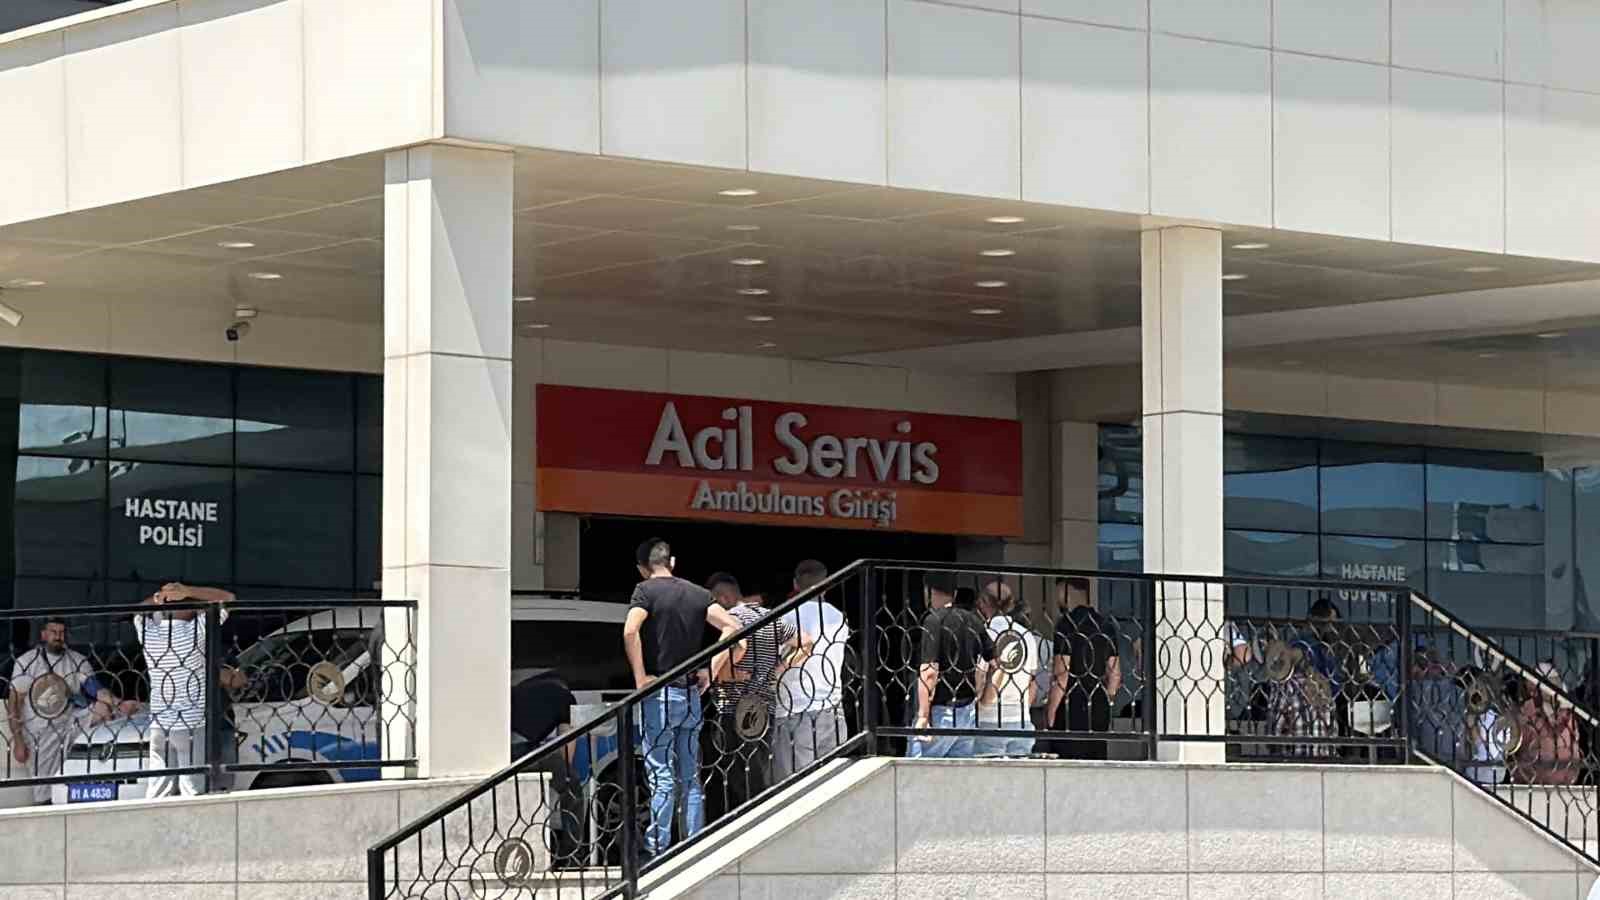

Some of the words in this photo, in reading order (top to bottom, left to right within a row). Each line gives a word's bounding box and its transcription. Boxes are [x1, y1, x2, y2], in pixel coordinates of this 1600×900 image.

[645, 401, 752, 471] Acil
[772, 412, 939, 485] Servis
[125, 498, 218, 521] HASTANE
[690, 479, 825, 516] Ambulans
[828, 487, 897, 528] Girişi
[140, 523, 203, 547] POLİSİ
[1341, 563, 1406, 581] HASTANE
